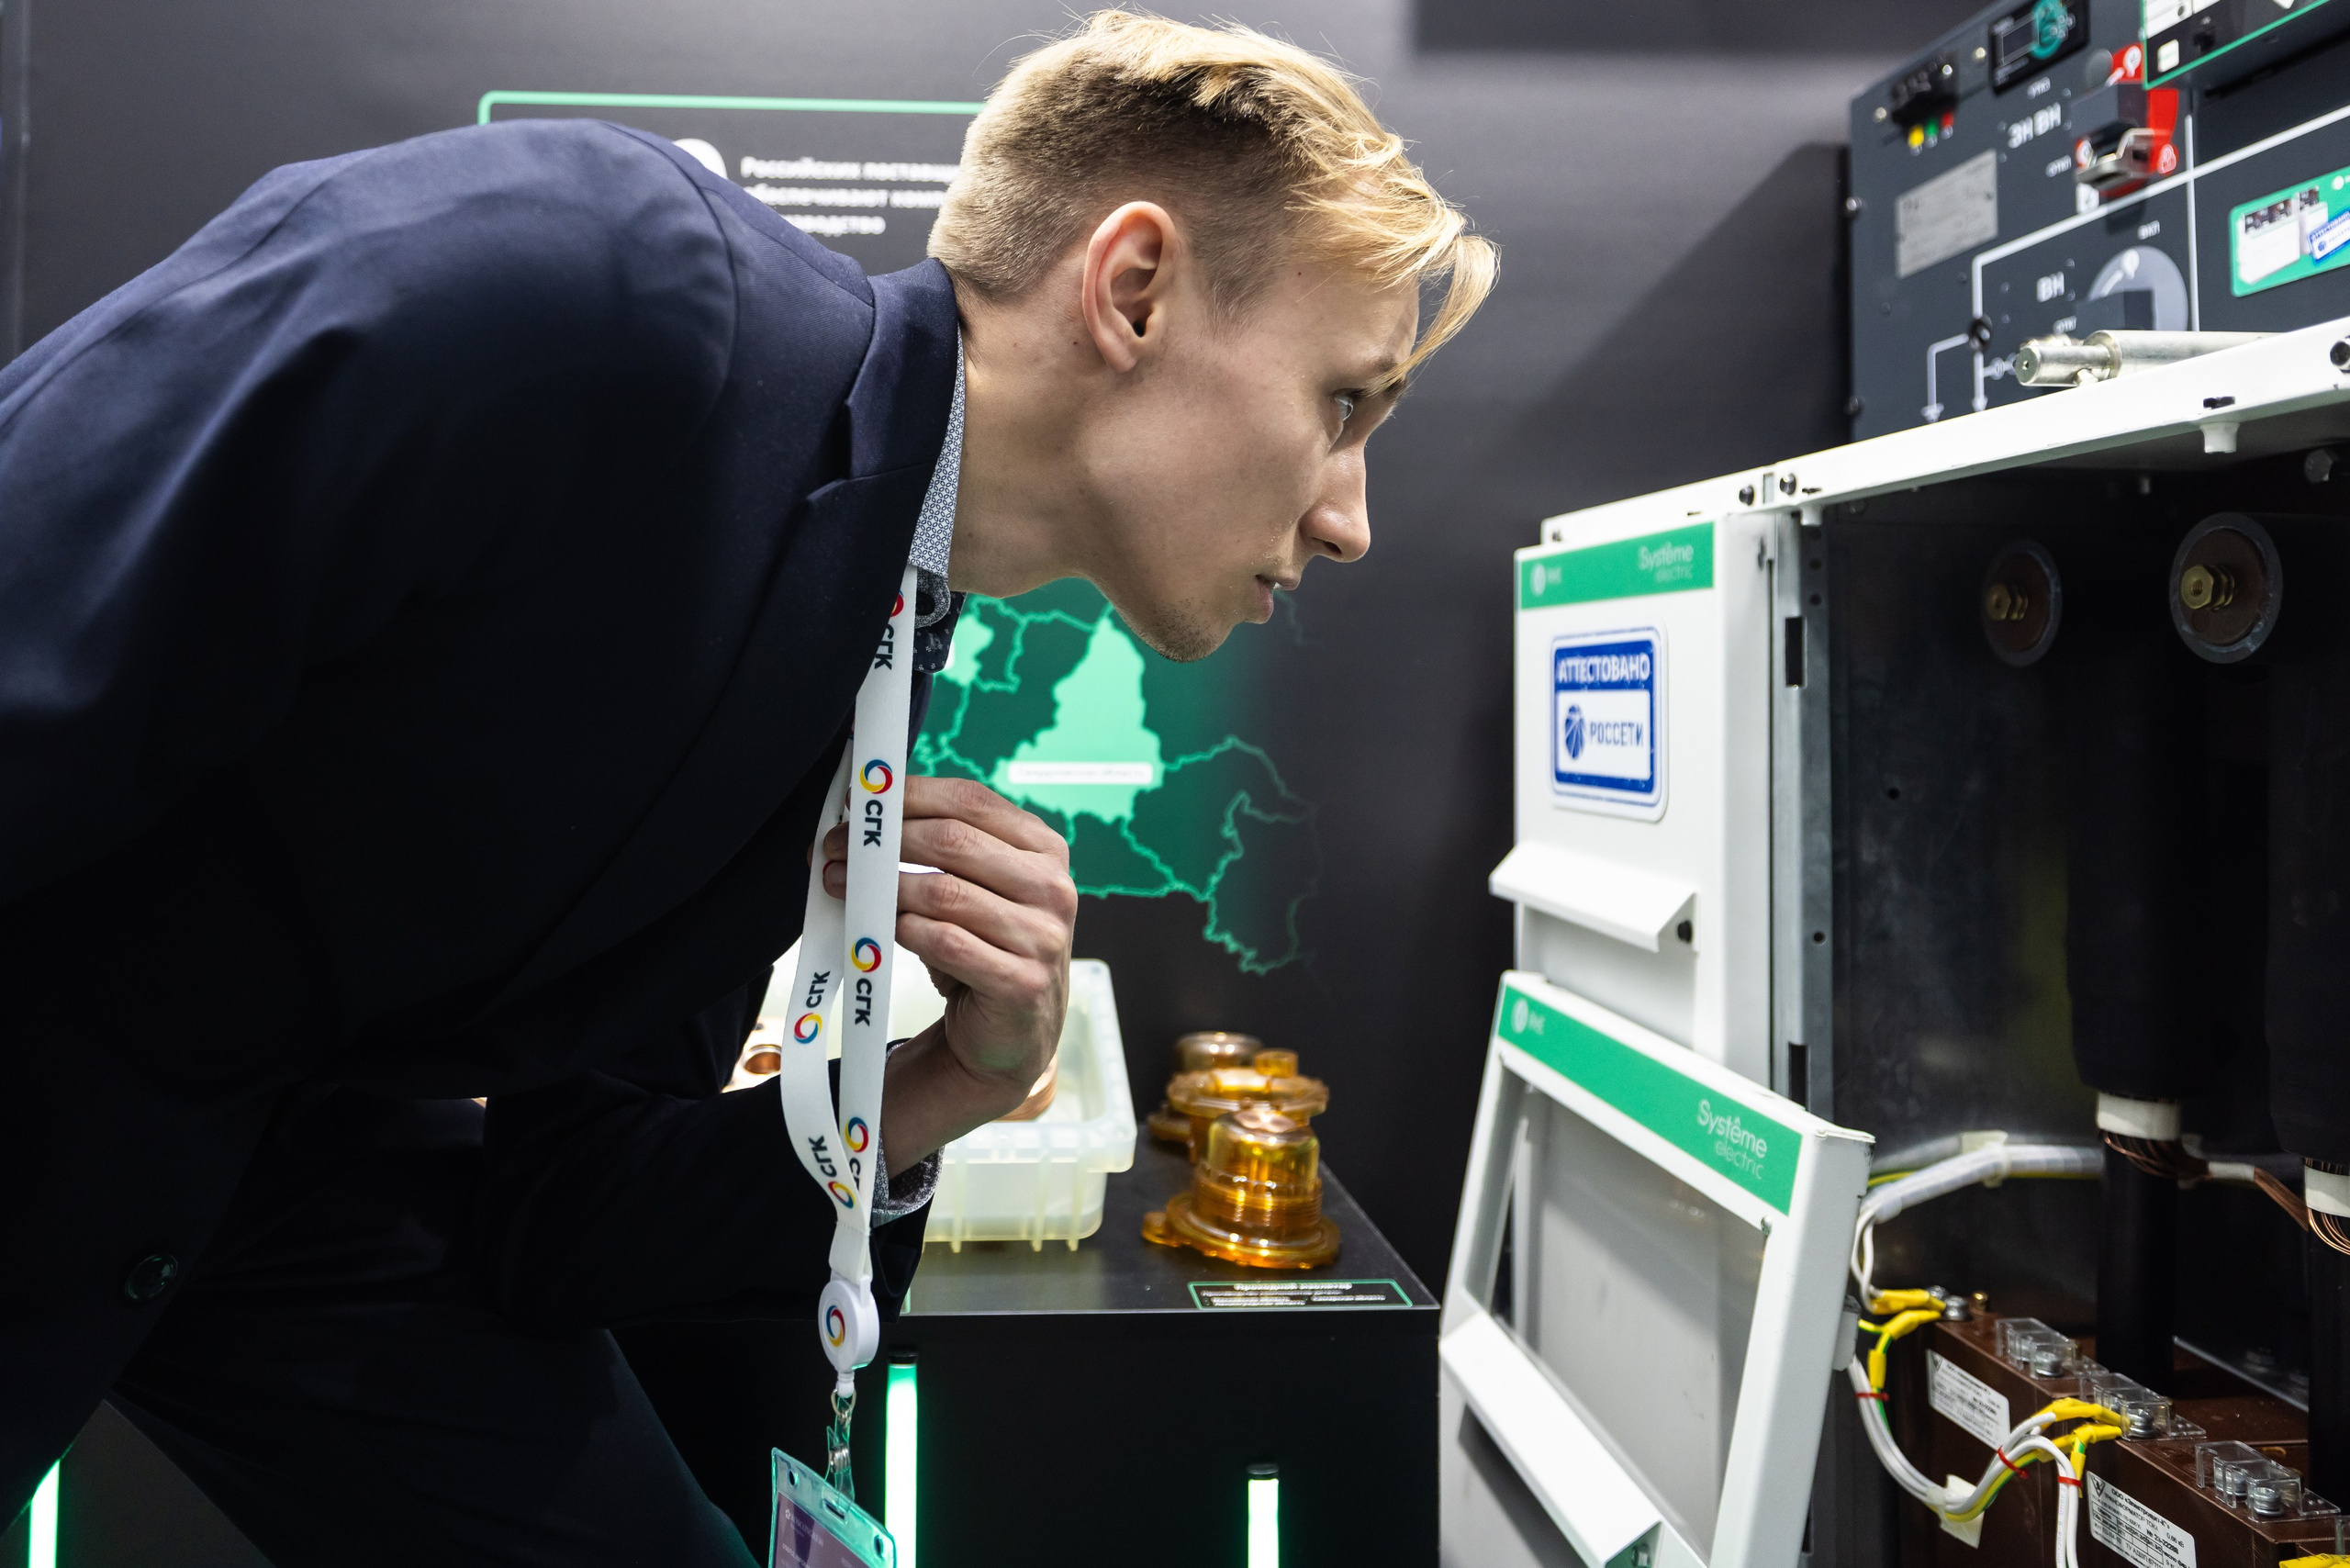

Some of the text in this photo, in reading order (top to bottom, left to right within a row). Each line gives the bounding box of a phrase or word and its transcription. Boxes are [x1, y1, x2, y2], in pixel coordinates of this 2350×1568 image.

[1558, 652, 1651, 686] АТТЕСТОВАНО
[1589, 718, 1644, 748] РОССЕТИ
[863, 799, 884, 847] СГК
[805, 969, 831, 1009] СГК
[854, 977, 874, 1027] СГК
[1696, 1098, 1768, 1159] Systême
[808, 1134, 837, 1179] СГК
[1714, 1140, 1762, 1181] electric
